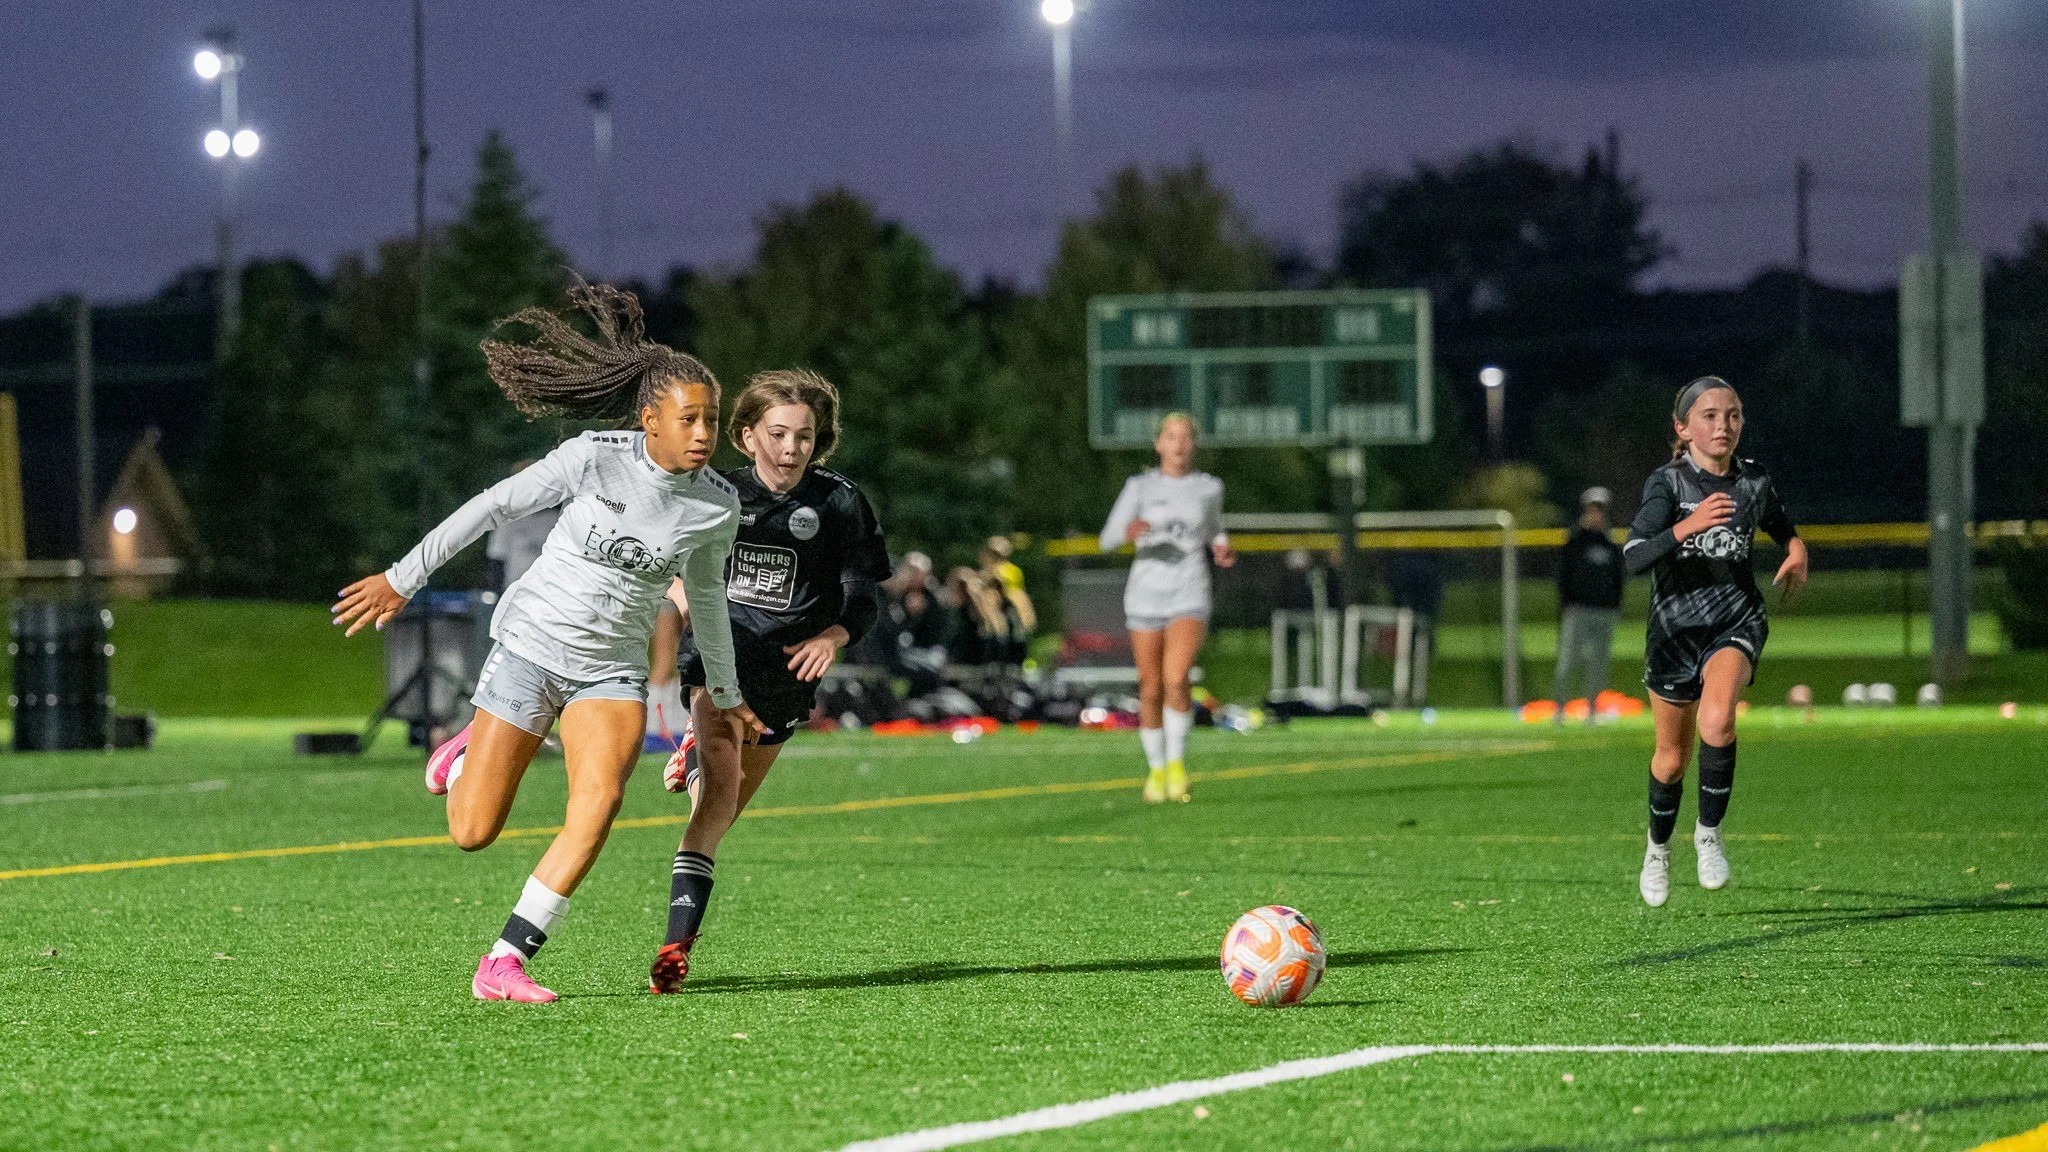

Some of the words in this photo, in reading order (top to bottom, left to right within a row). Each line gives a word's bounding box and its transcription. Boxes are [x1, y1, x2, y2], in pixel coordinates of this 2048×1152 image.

[595, 494, 627, 513] capelli
[738, 548, 791, 567] LEARNERS
[737, 562, 756, 574] LOG
[736, 574, 751, 587] ON
[487, 689, 512, 705] TRUIST
